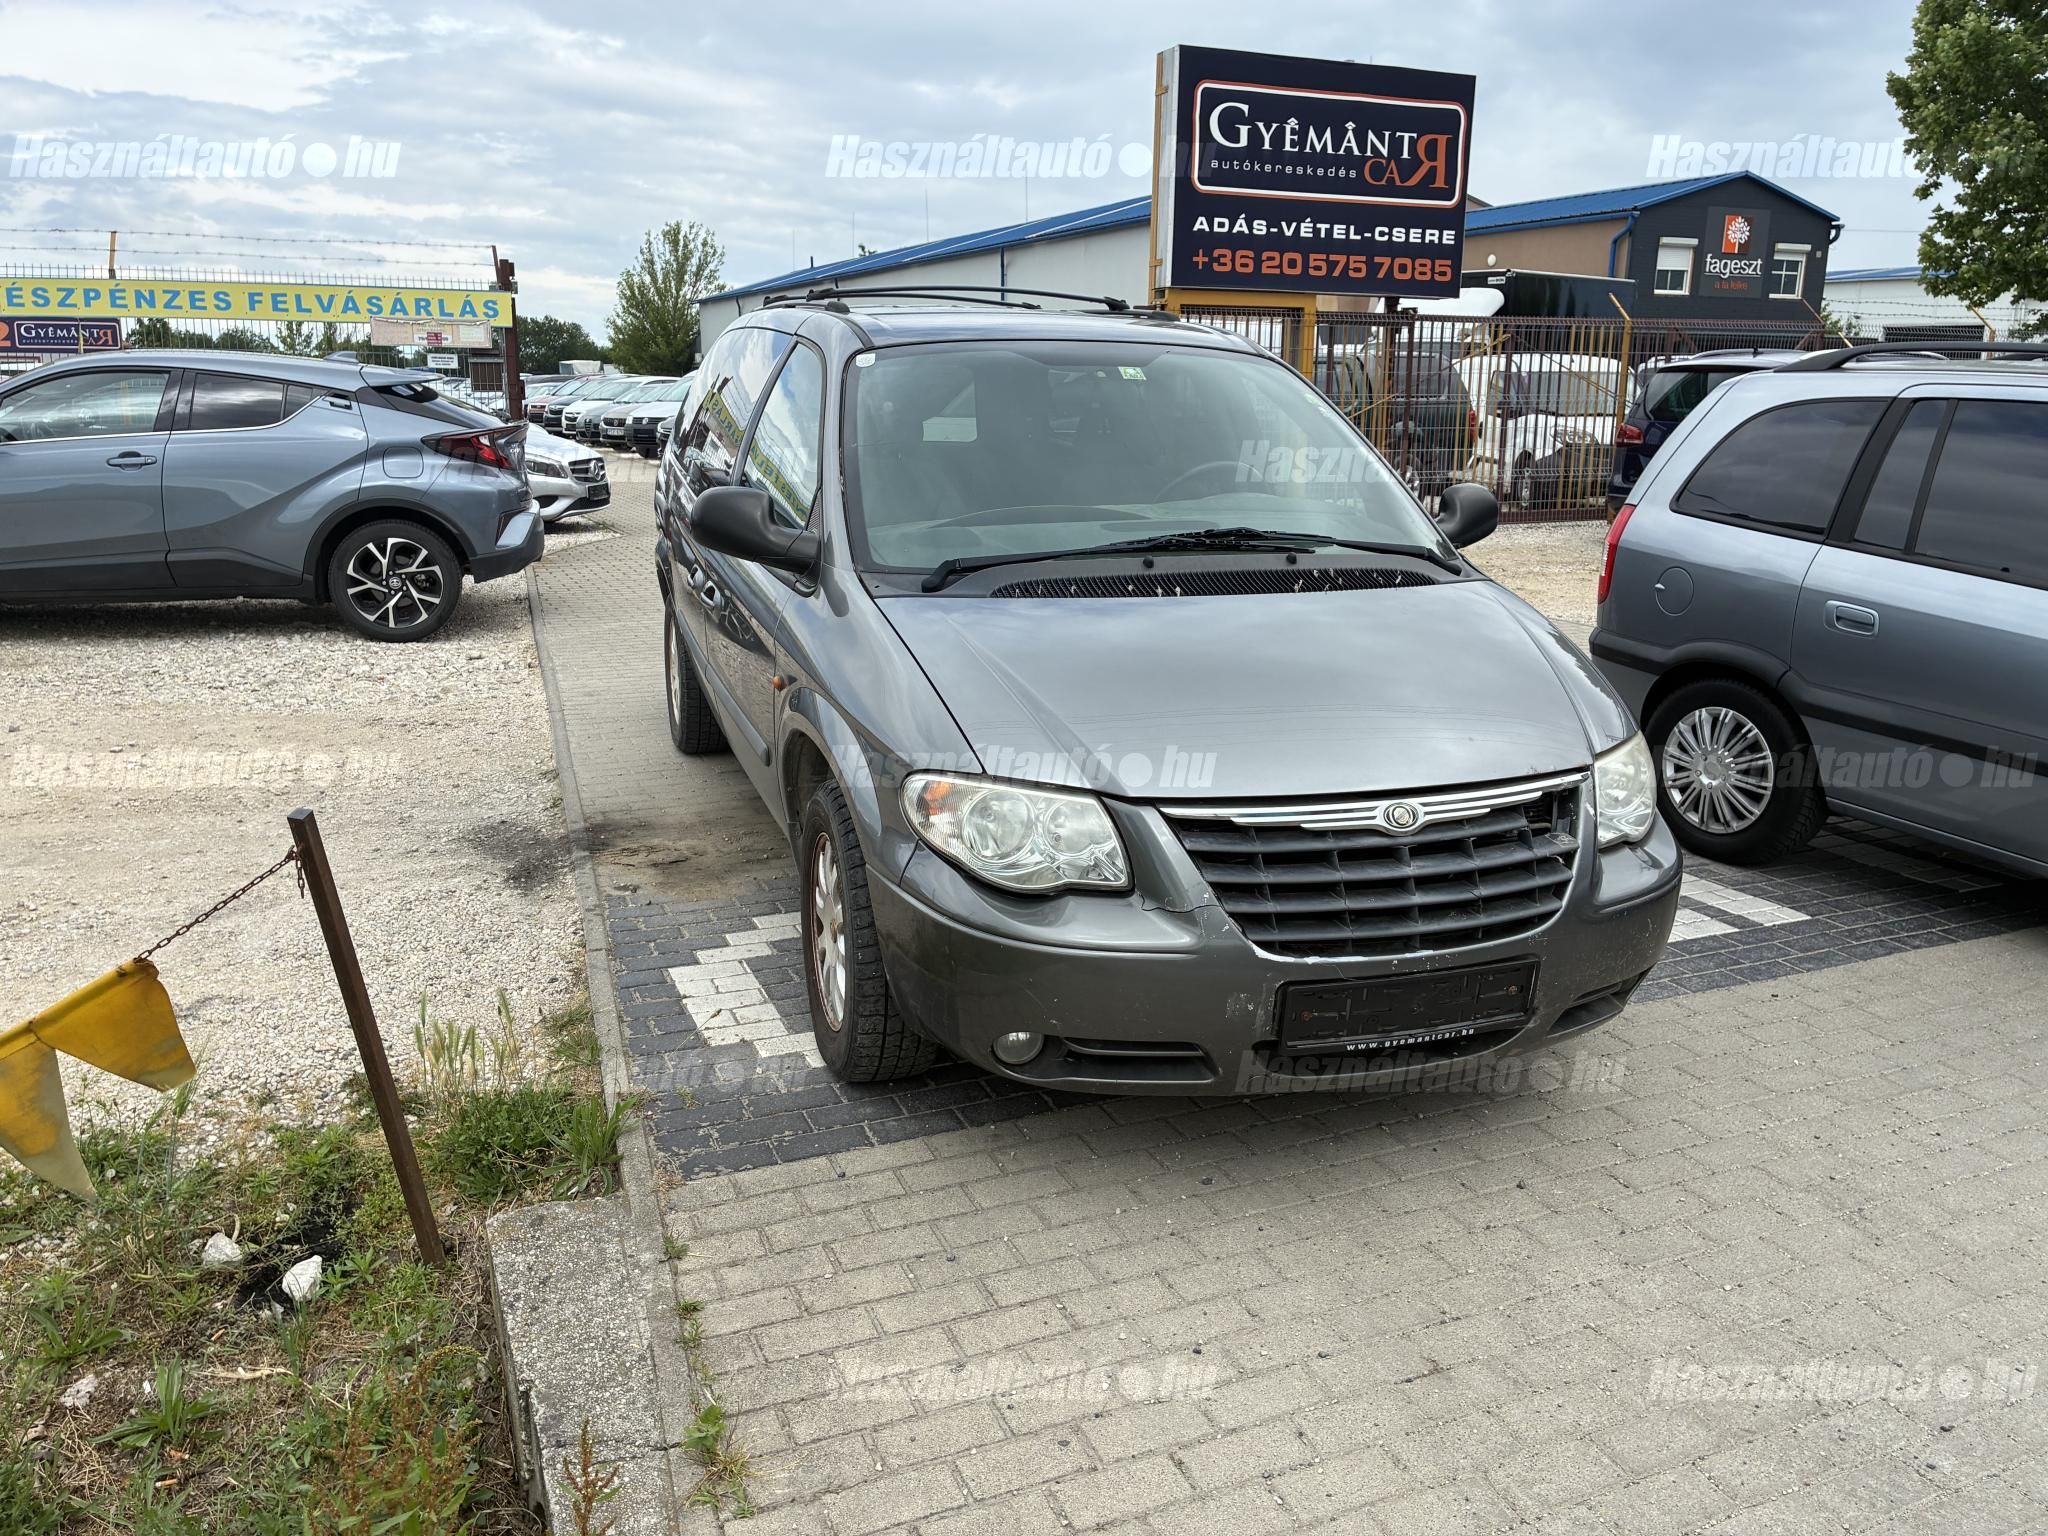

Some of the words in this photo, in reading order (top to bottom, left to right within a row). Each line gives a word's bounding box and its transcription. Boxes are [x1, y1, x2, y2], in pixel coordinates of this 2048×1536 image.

[1210, 159, 1358, 179] autókereskedés
[1192, 249, 1255, 273] +36
[1261, 252, 1303, 275] 20
[1308, 254, 1367, 278] 575
[1373, 257, 1452, 282] 7085
[1704, 253, 1763, 278] fageszt
[5, 281, 232, 311] ÉSZPÉNZES
[247, 290, 500, 319] FELVÁSÁRLÁS
